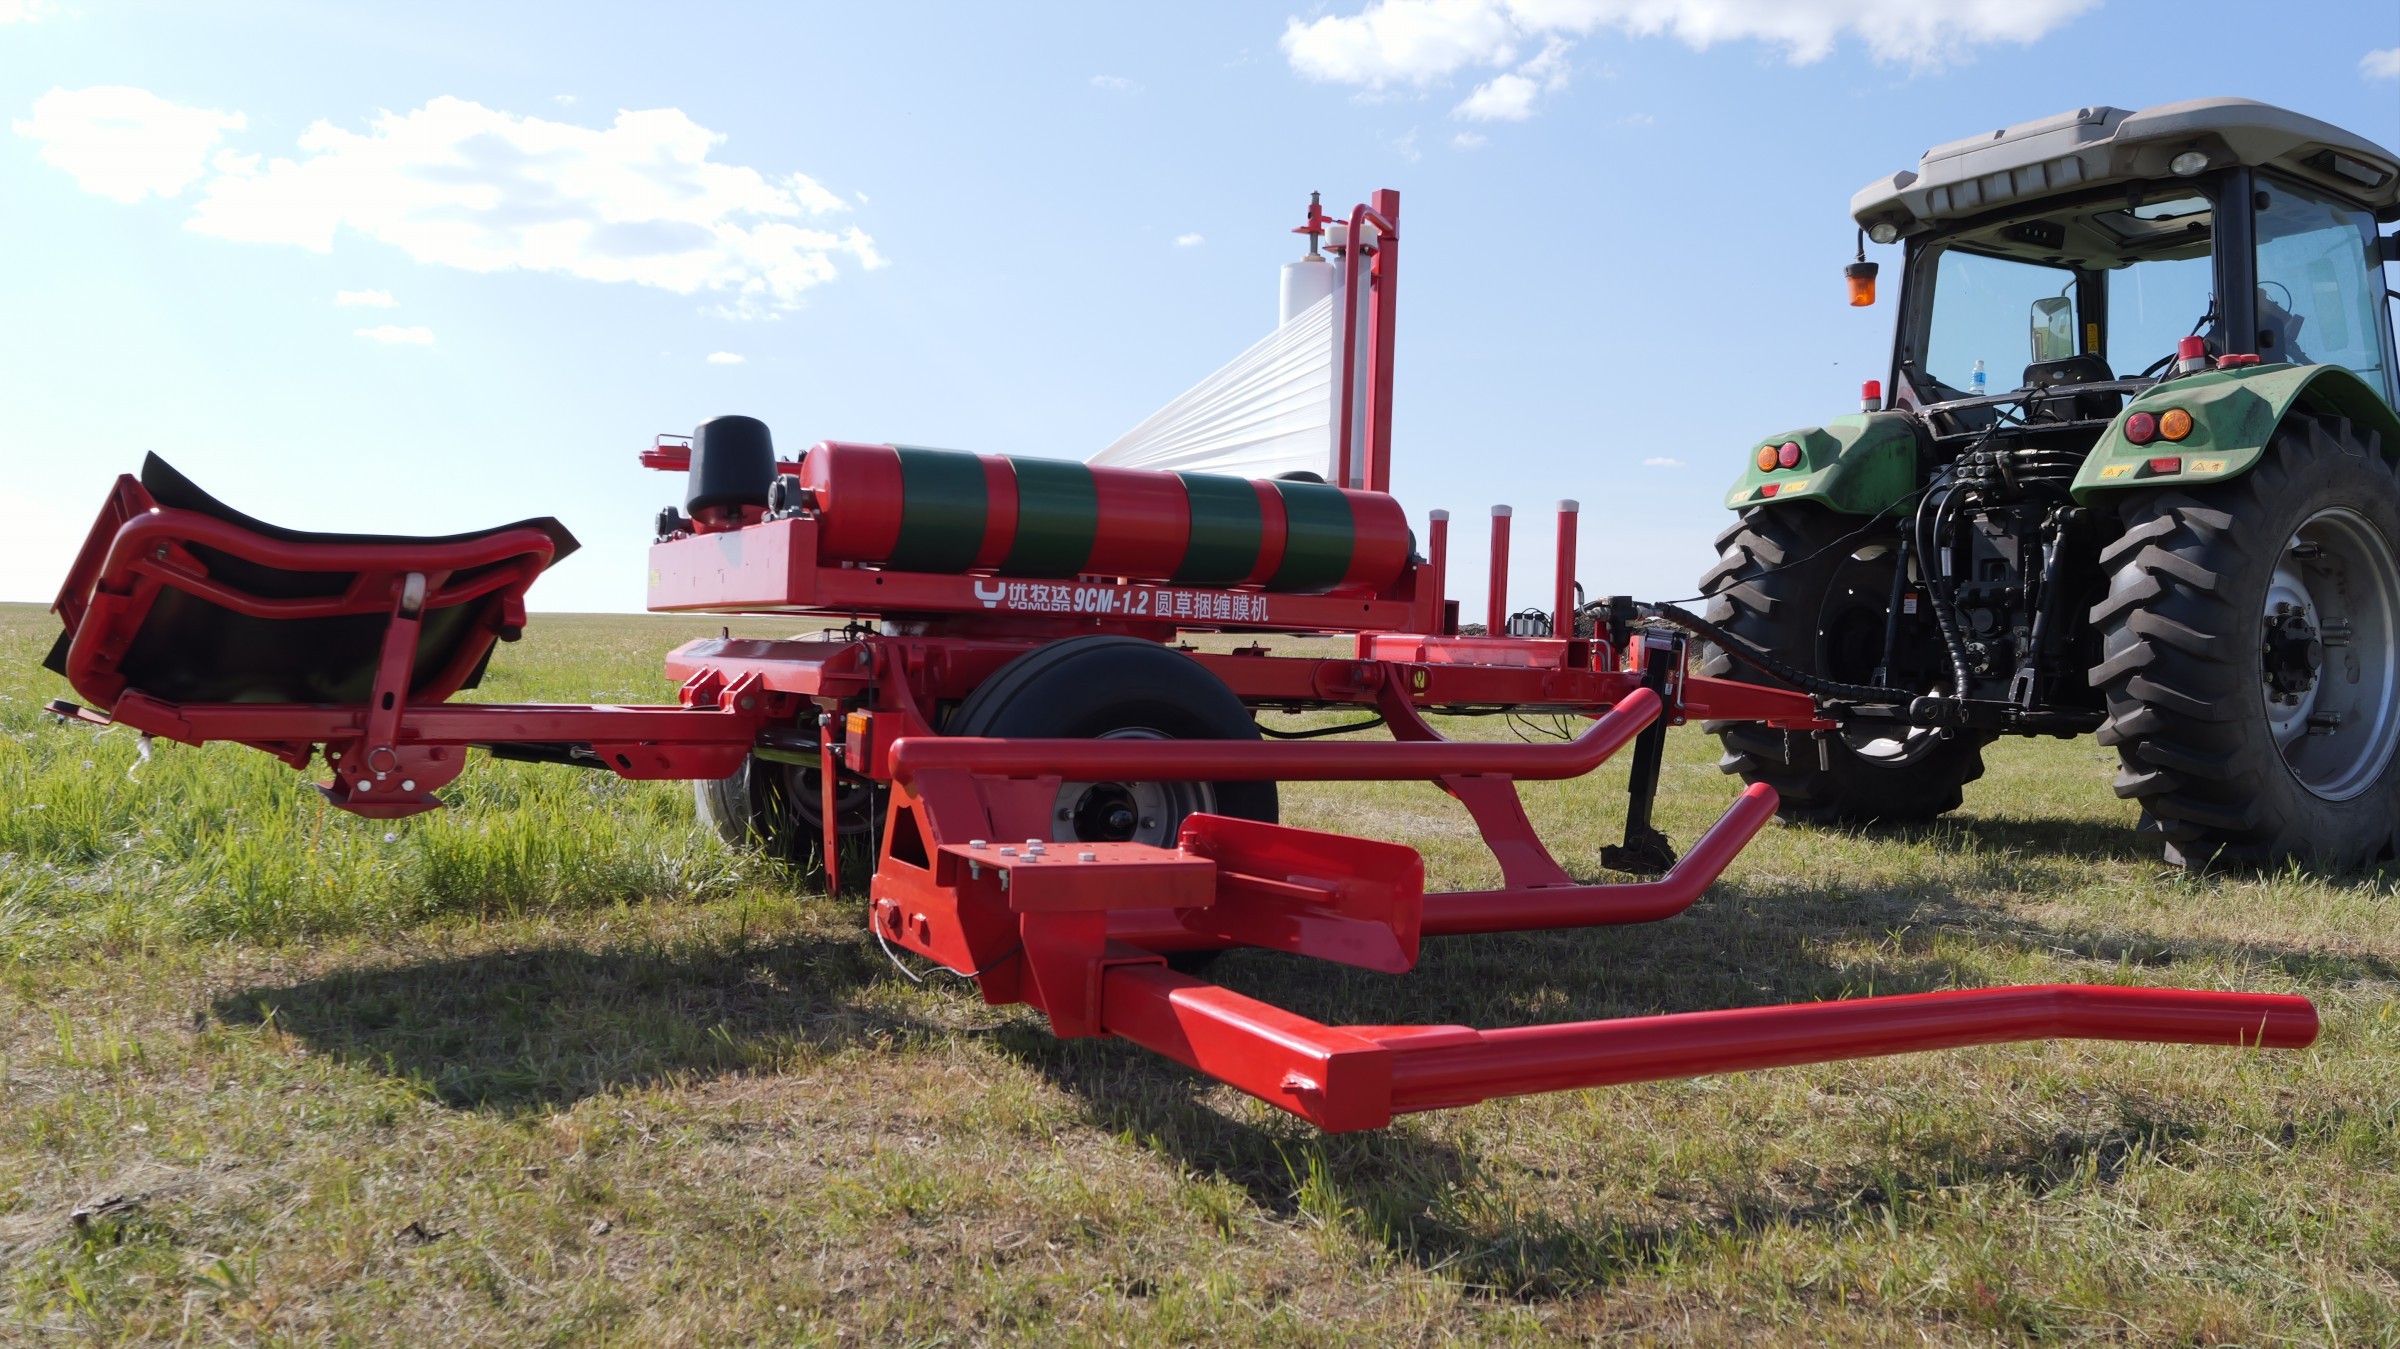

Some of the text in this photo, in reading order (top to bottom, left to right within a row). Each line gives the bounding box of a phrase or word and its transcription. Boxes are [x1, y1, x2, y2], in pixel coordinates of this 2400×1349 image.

[1008, 583, 1071, 603] 优牧达
[1008, 601, 1071, 612] YOMUDA
[1073, 587, 1269, 621] 9CM-1.2 圆草捆缠膜机
